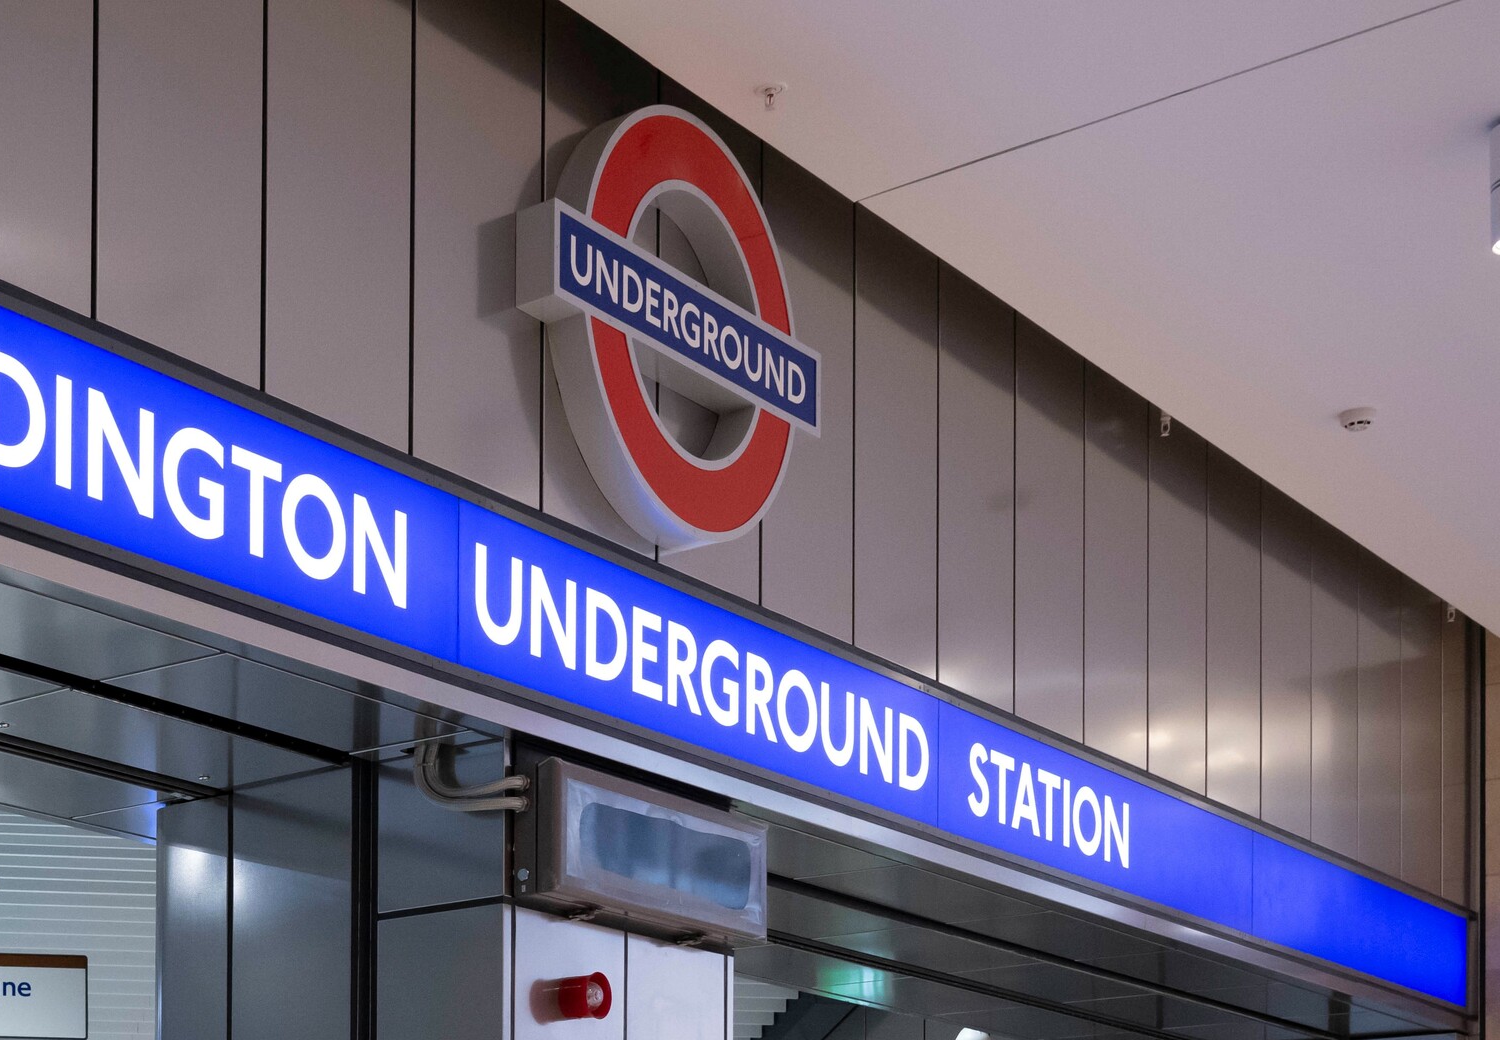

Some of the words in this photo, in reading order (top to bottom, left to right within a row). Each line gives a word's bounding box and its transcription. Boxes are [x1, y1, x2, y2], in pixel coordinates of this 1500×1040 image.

[570, 234, 806, 405] UNDERGROUND
[474, 541, 930, 792] UNDERGROUND
[966, 741, 1131, 869] STATION
